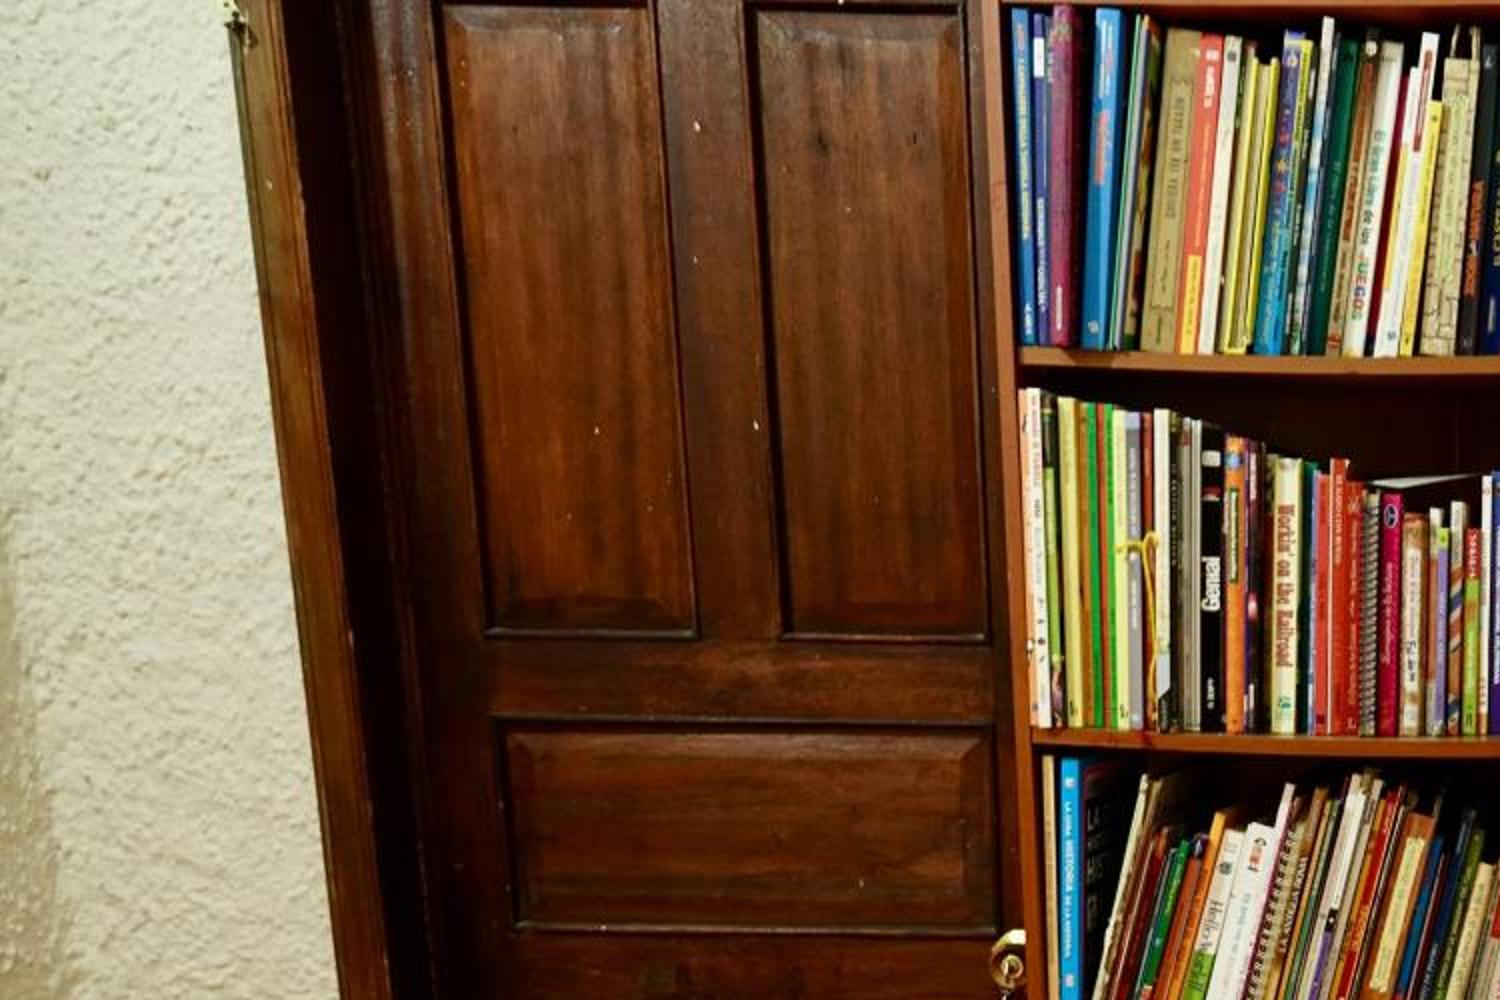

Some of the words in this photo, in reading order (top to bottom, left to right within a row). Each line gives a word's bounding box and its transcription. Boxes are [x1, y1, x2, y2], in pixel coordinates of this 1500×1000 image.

[1277, 504, 1296, 556] Workin'
[1200, 555, 1222, 614] Genial
[1277, 561, 1290, 577] on
[1276, 583, 1293, 605] the
[1274, 610, 1295, 669] Railroad
[1204, 900, 1224, 938] Hello
